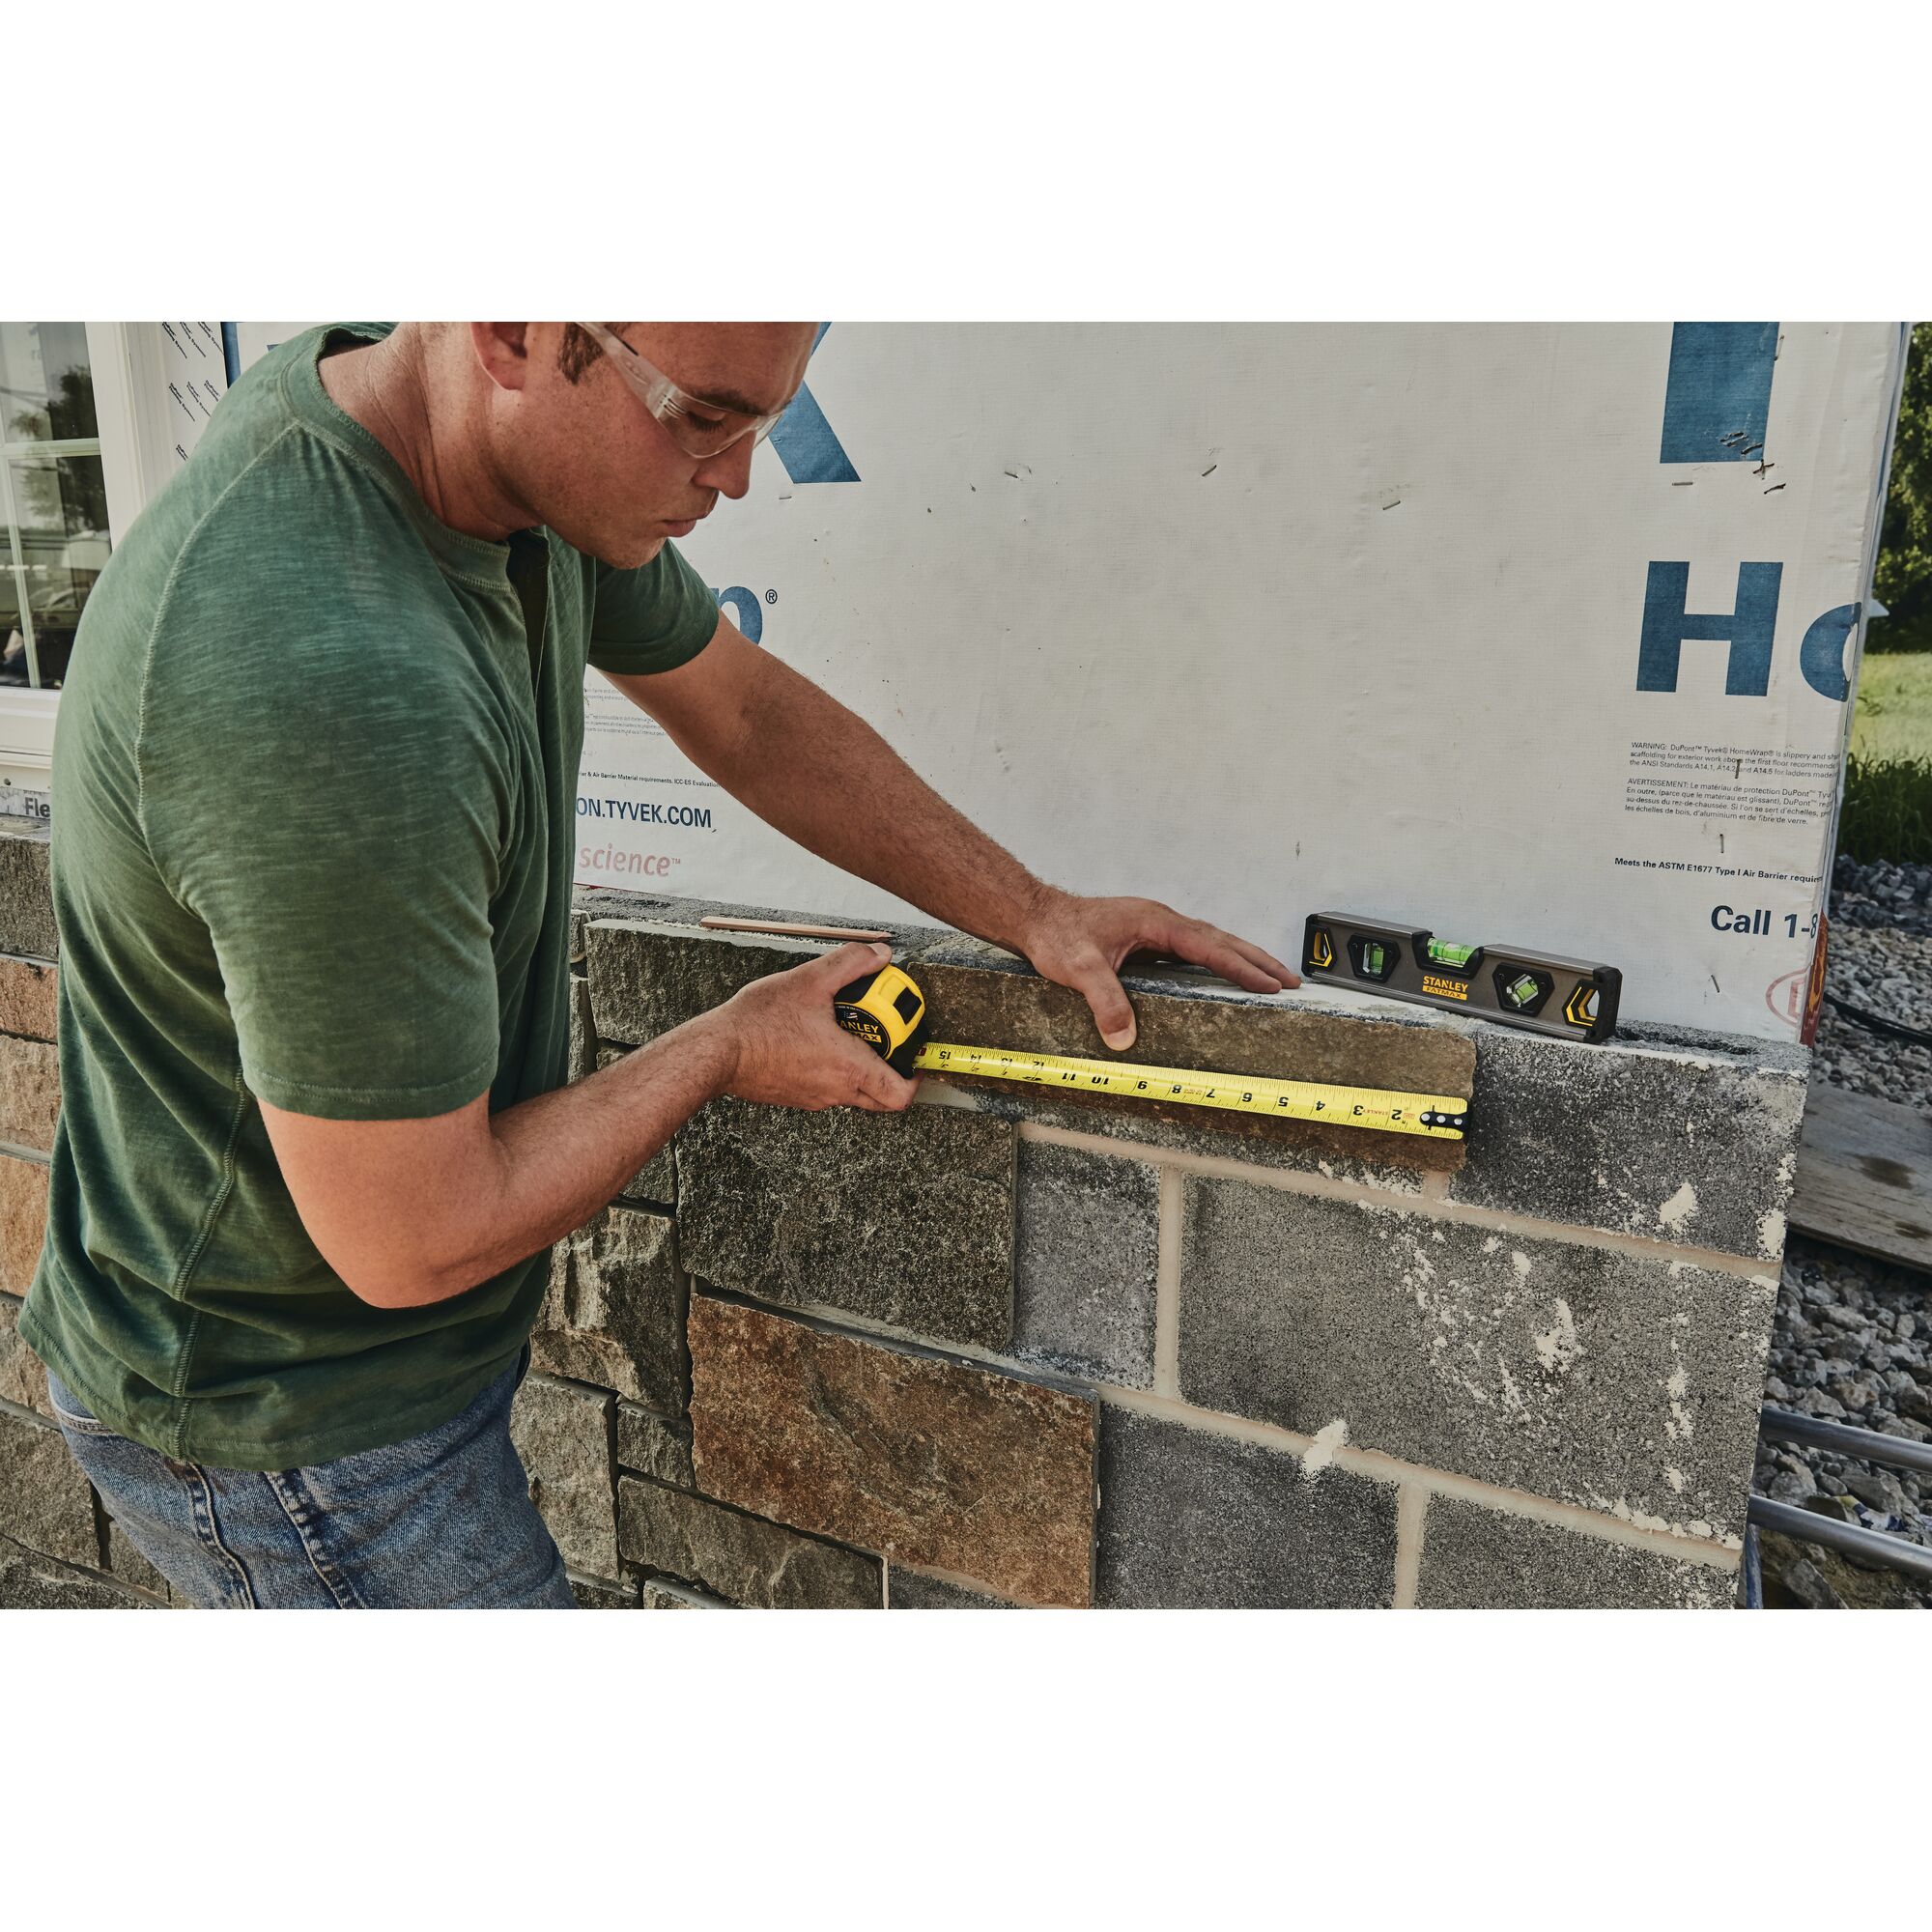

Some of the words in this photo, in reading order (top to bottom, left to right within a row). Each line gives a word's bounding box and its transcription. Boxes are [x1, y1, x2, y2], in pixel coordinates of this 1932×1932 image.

[1631, 742, 1667, 751] WARNING:
[1783, 752, 1810, 760] slippery
[1631, 751, 1665, 759] scaffolding
[1627, 778, 1689, 788] AVERTISSEMENT:
[1744, 786, 1779, 795] protection
[1659, 789, 1680, 798] (parce
[1614, 858, 1640, 867] Meets
[1659, 862, 1685, 870] ASTM
[1687, 864, 1713, 873] E1677
[1716, 867, 1736, 876] Type
[1758, 870, 1788, 880] Barrier
[1711, 905, 1772, 936] Call
[1423, 976, 1468, 993] STANLEY
[1425, 986, 1463, 999] FATMAX
[939, 1051, 952, 1060] 15
[970, 1054, 981, 1064] 14
[1002, 1058, 1012, 1066] 13
[1033, 1061, 1044, 1070] 12
[1062, 1072, 1076, 1081] 11
[1092, 1076, 1109, 1085] 10
[1137, 1081, 1148, 1090] 9
[1172, 1084, 1181, 1094] 8
[1206, 1089, 1215, 1098] 7
[1242, 1093, 1253, 1102] 6
[1278, 1096, 1289, 1107] 5
[1316, 1101, 1325, 1111] 4
[1353, 1105, 1364, 1116] 3
[1391, 1109, 1403, 1120] 2
